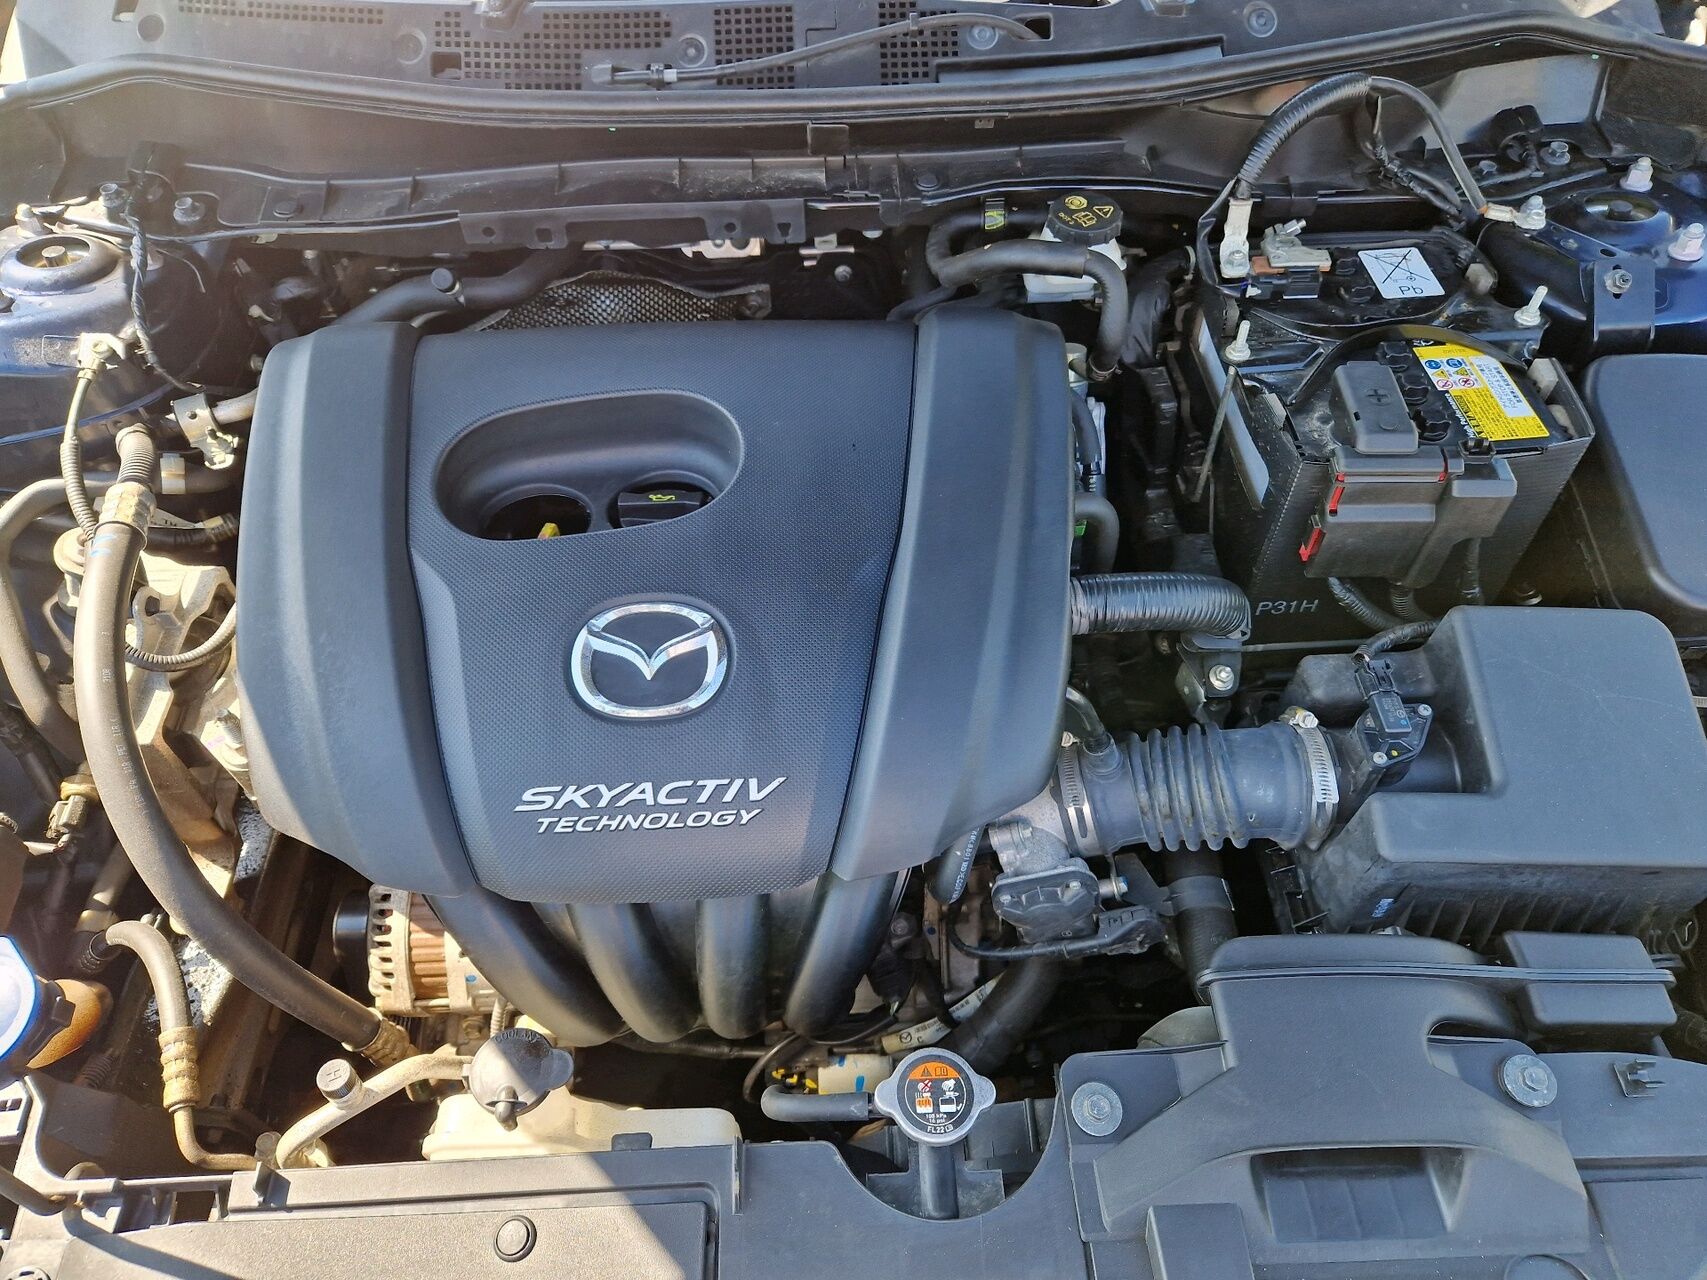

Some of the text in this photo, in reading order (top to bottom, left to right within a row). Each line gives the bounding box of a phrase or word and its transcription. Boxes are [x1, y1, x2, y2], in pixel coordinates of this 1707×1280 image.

[1399, 285, 1423, 295] Pb
[1445, 393, 1468, 425] Performance
[1255, 599, 1319, 616] P31H
[514, 777, 787, 812] SKYACTIV
[537, 808, 764, 834] TECHNOLOGY
[927, 1125, 945, 1133] FL22
